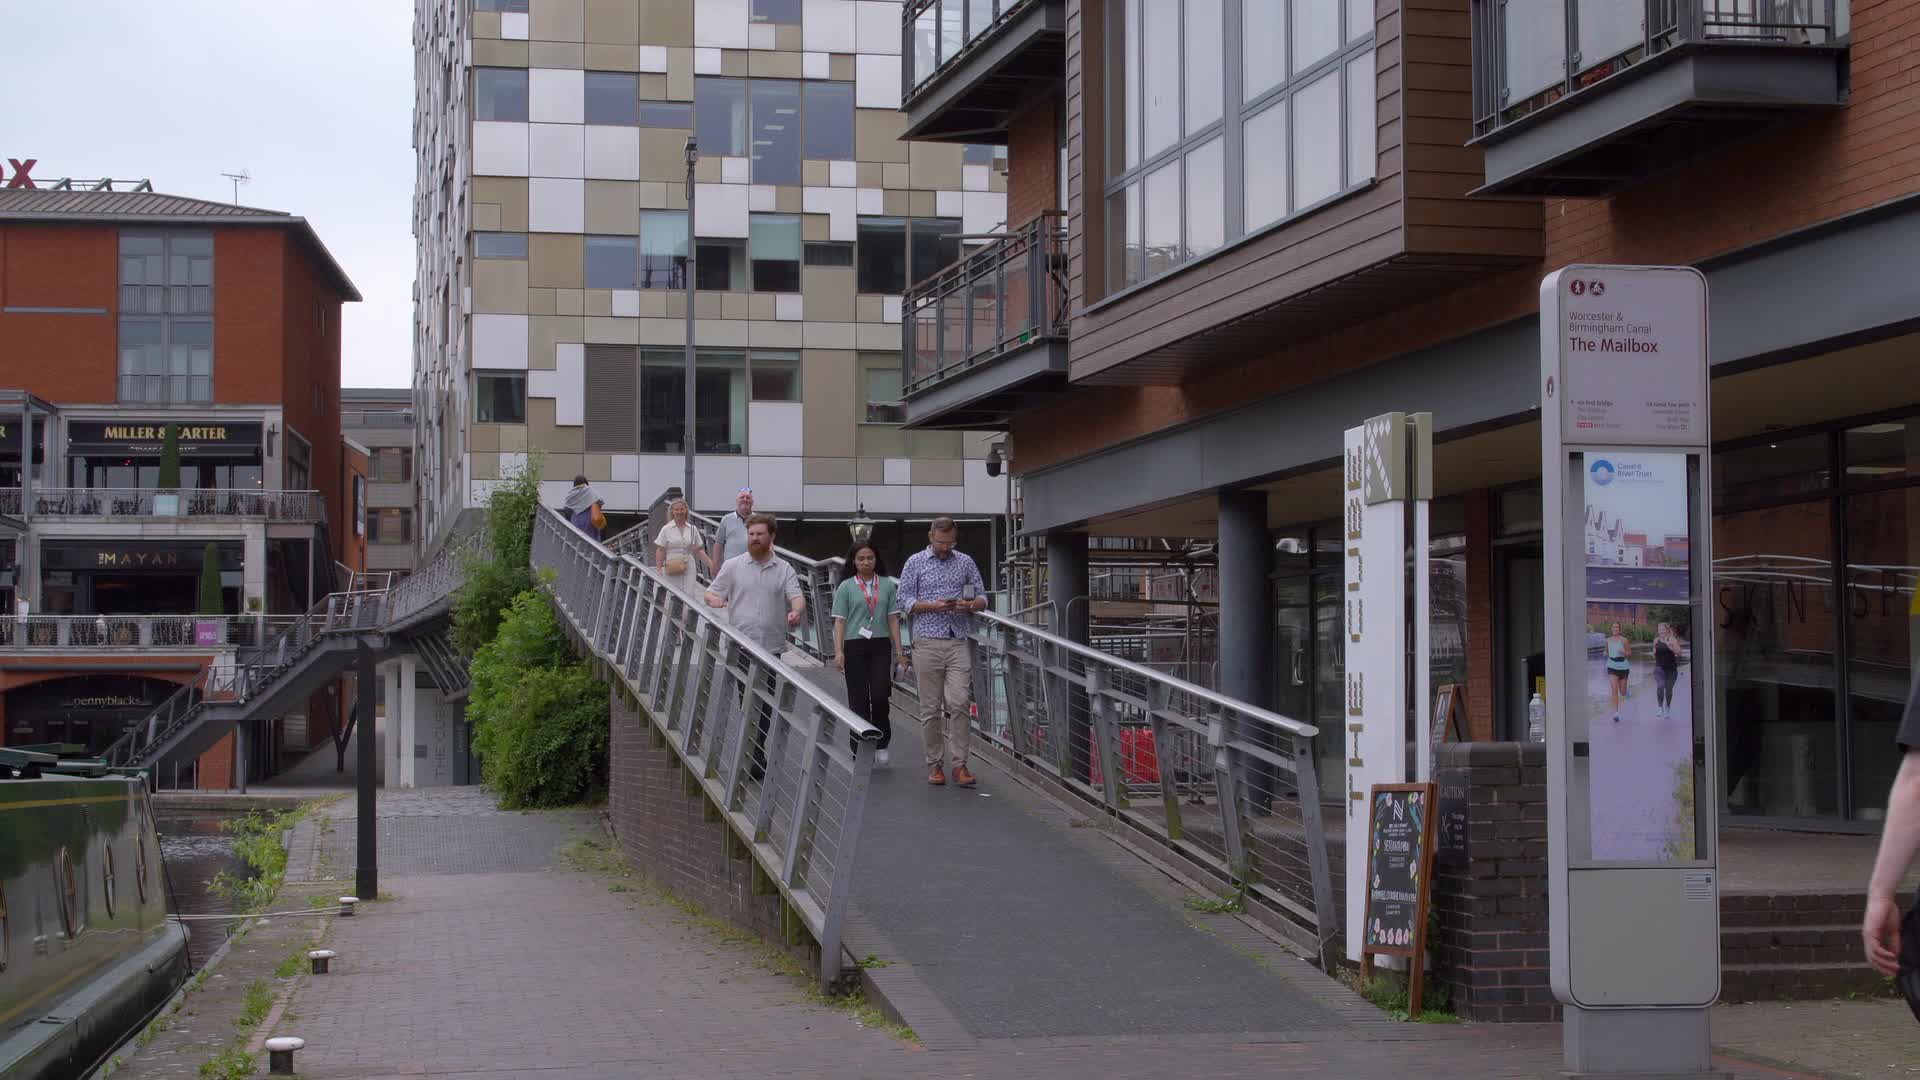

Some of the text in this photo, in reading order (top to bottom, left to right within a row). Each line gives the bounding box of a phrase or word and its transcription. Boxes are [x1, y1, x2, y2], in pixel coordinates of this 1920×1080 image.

[0, 158, 38, 189] X
[1569, 311, 1623, 321] Worcester &
[1569, 323, 1652, 334] Birmingham Canal
[1569, 337, 1659, 353] The Mailbox
[104, 426, 155, 439] MILLER
[157, 426, 166, 439] &
[104, 552, 177, 565] MAYAN
[73, 695, 141, 708] pennyblacks
